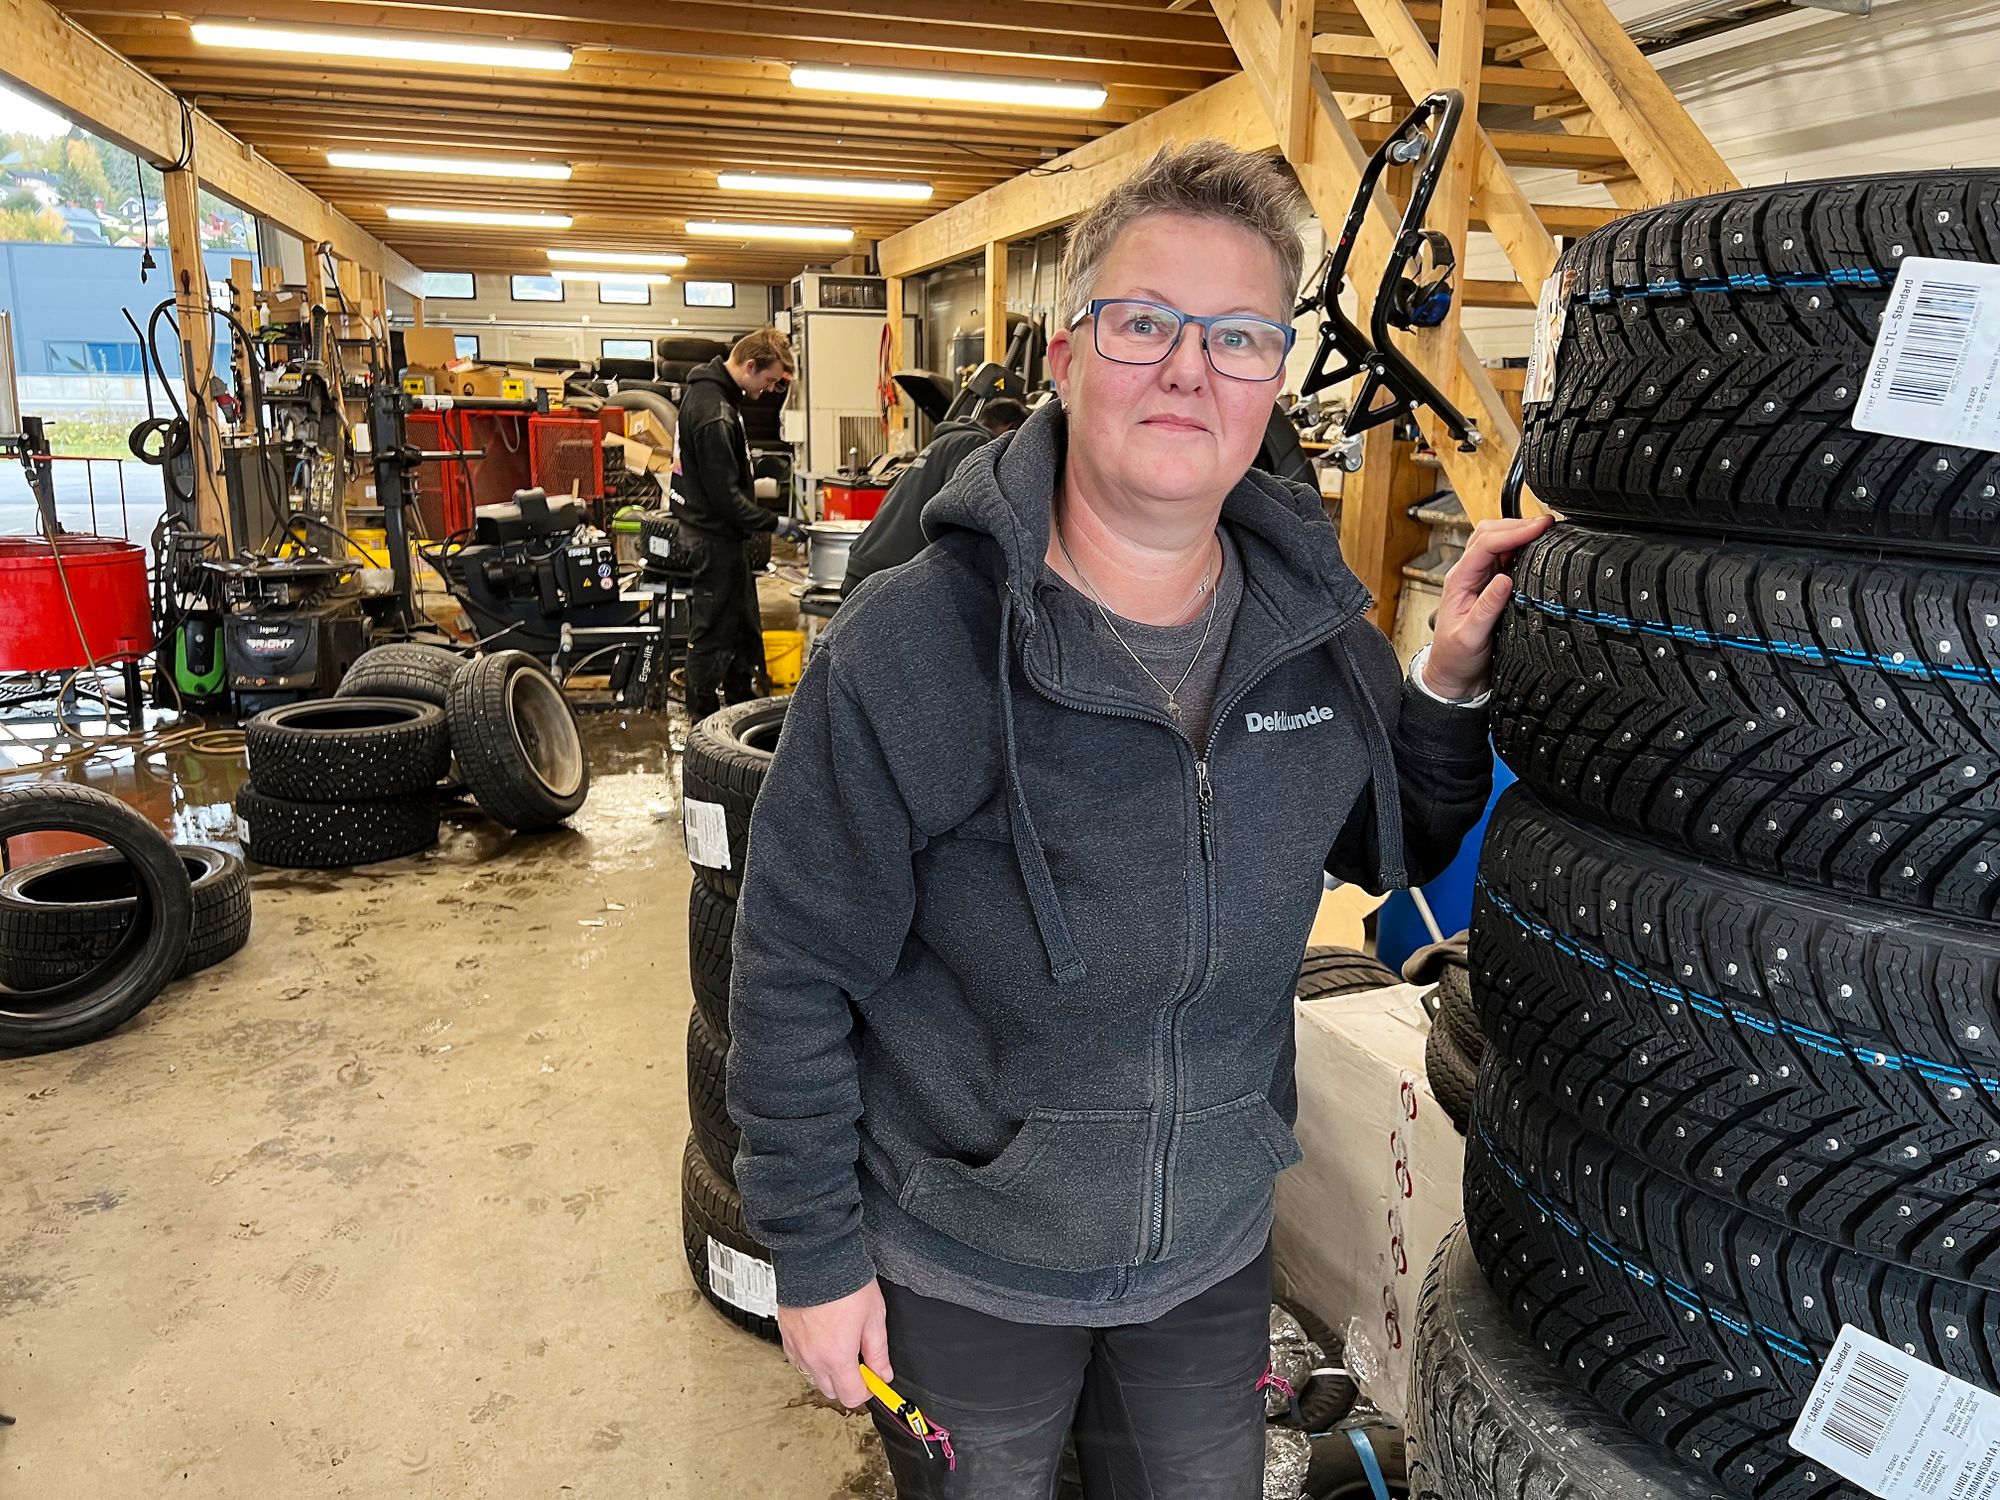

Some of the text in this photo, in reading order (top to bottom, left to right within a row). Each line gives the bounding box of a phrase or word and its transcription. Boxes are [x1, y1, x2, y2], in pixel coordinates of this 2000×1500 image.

[1871, 357, 1889, 389] CARGO
[1884, 330, 1898, 347] LTL
[1892, 279, 1914, 320] Standard
[1808, 1397, 1825, 1422] CARGO
[1822, 1380, 1834, 1394] LTL
[1831, 1342, 1852, 1374] Standard
[1952, 1460, 1977, 1496] LUNDE AS
